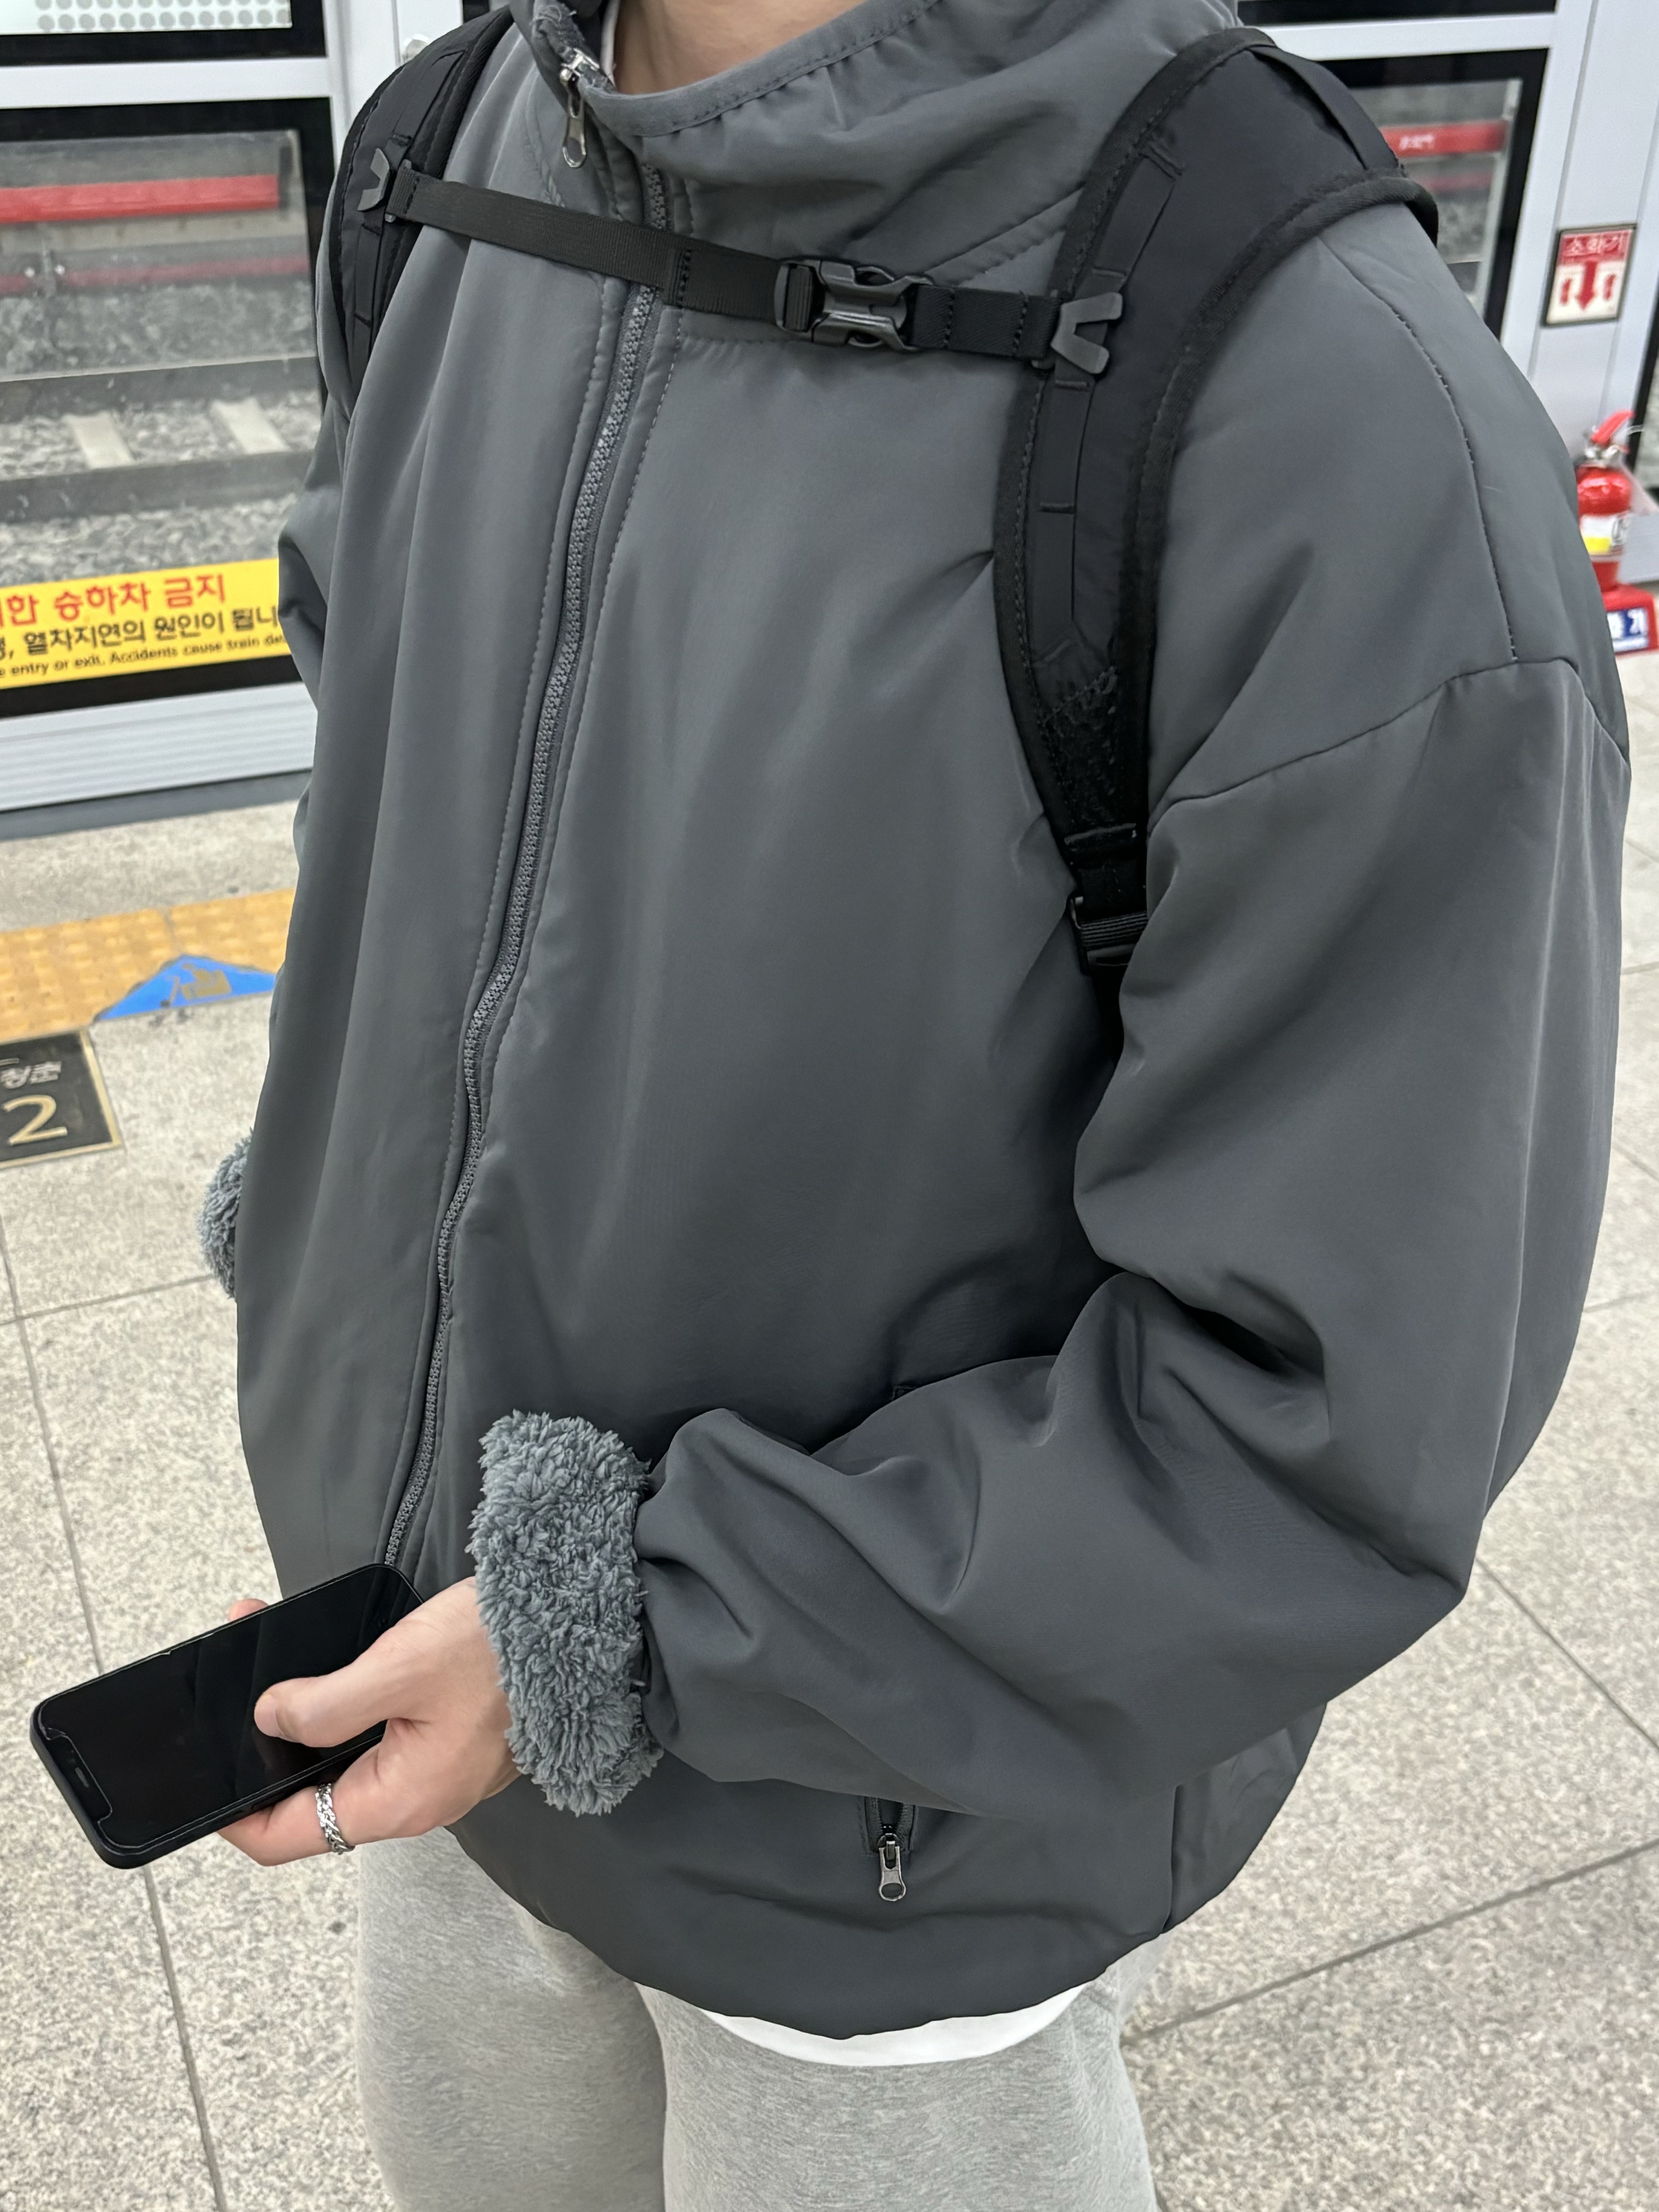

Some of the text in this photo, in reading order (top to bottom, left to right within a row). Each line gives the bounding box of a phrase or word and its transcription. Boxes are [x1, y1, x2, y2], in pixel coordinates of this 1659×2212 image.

[0, 574, 226, 628] 한 승하차 금지
[24, 620, 146, 656] 열차지연의
[154, 611, 225, 641] 원인이
[11, 662, 48, 676] entry
[54, 660, 69, 670] or
[110, 646, 178, 664] Accidents
[3, 1094, 68, 1146] 2
